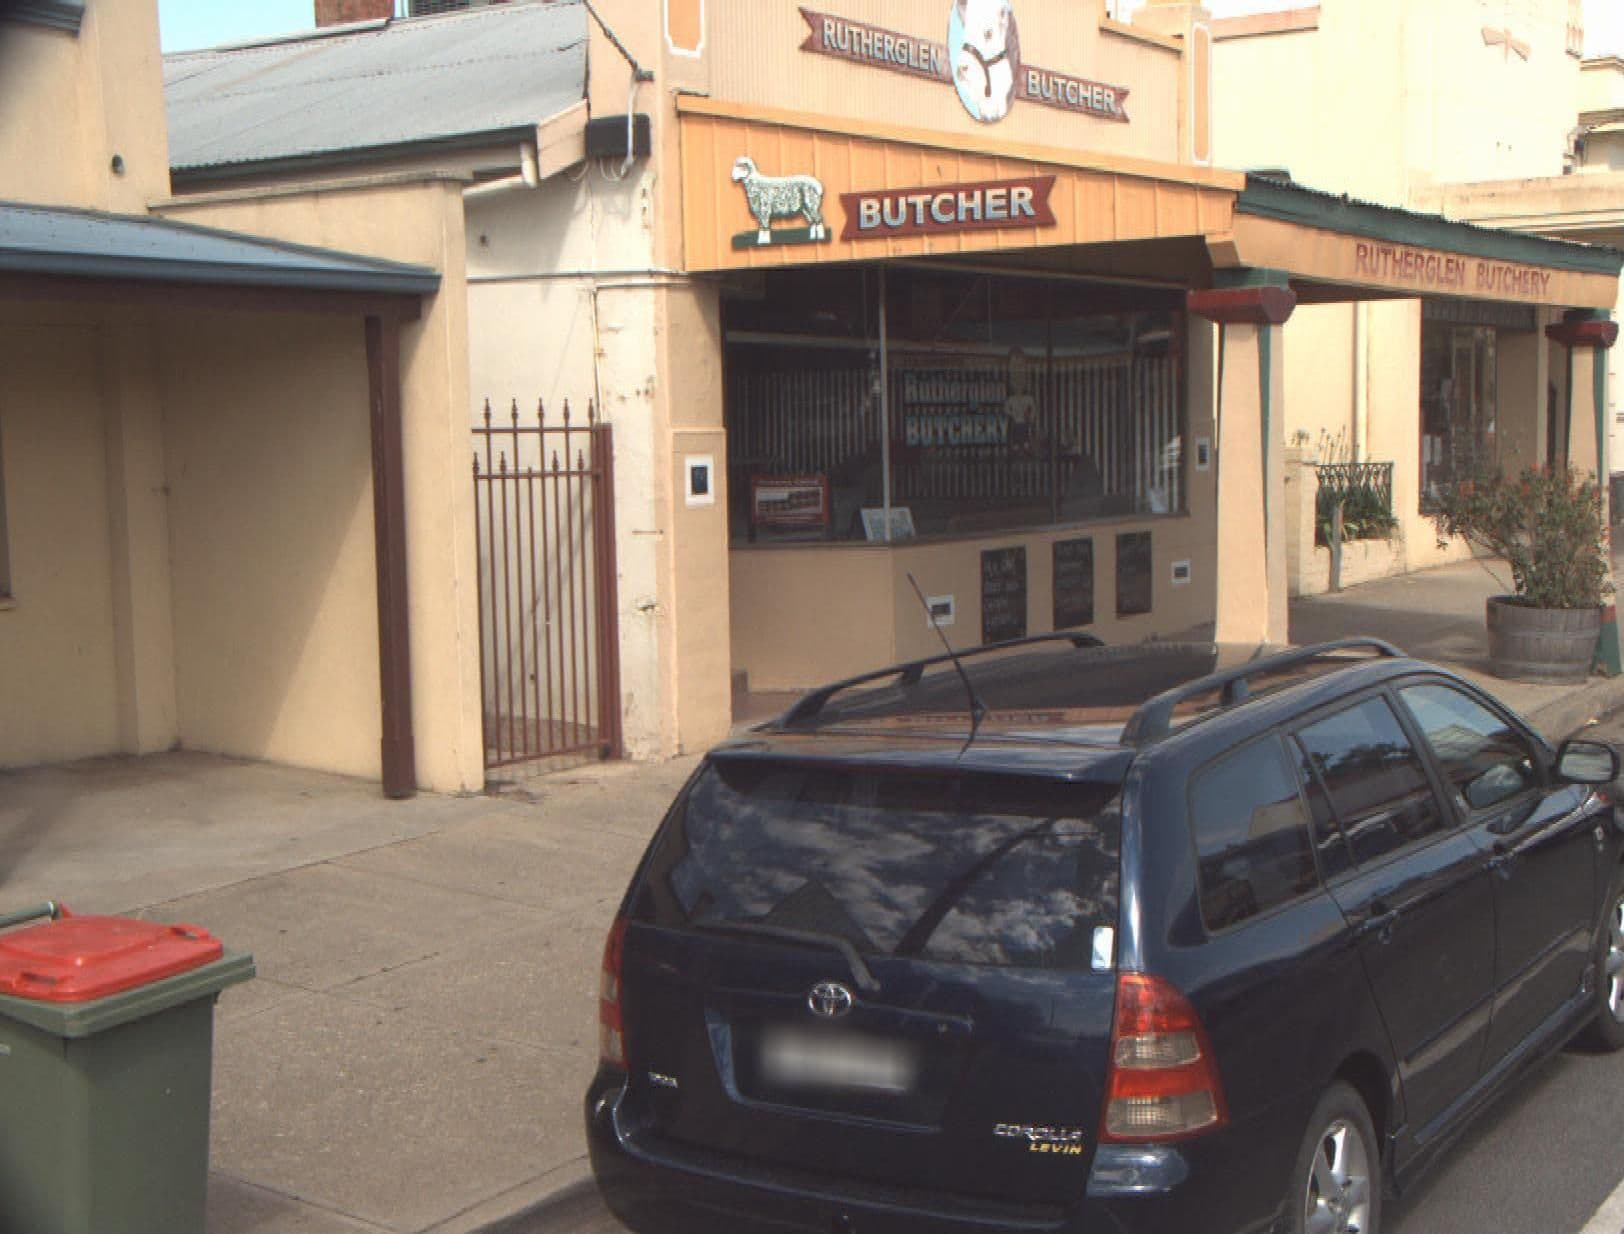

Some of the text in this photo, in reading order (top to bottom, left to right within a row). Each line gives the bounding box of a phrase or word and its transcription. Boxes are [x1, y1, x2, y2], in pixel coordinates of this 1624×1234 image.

[822, 18, 1117, 111] RUTHERGLEN BUTCHER
[859, 186, 1035, 230] BUTCHER
[1355, 243, 1551, 296] RUTHERGLEN BUTCHERY
[905, 415, 1010, 447] BUTCHERY
[1029, 1143, 1083, 1155] LEVIN
